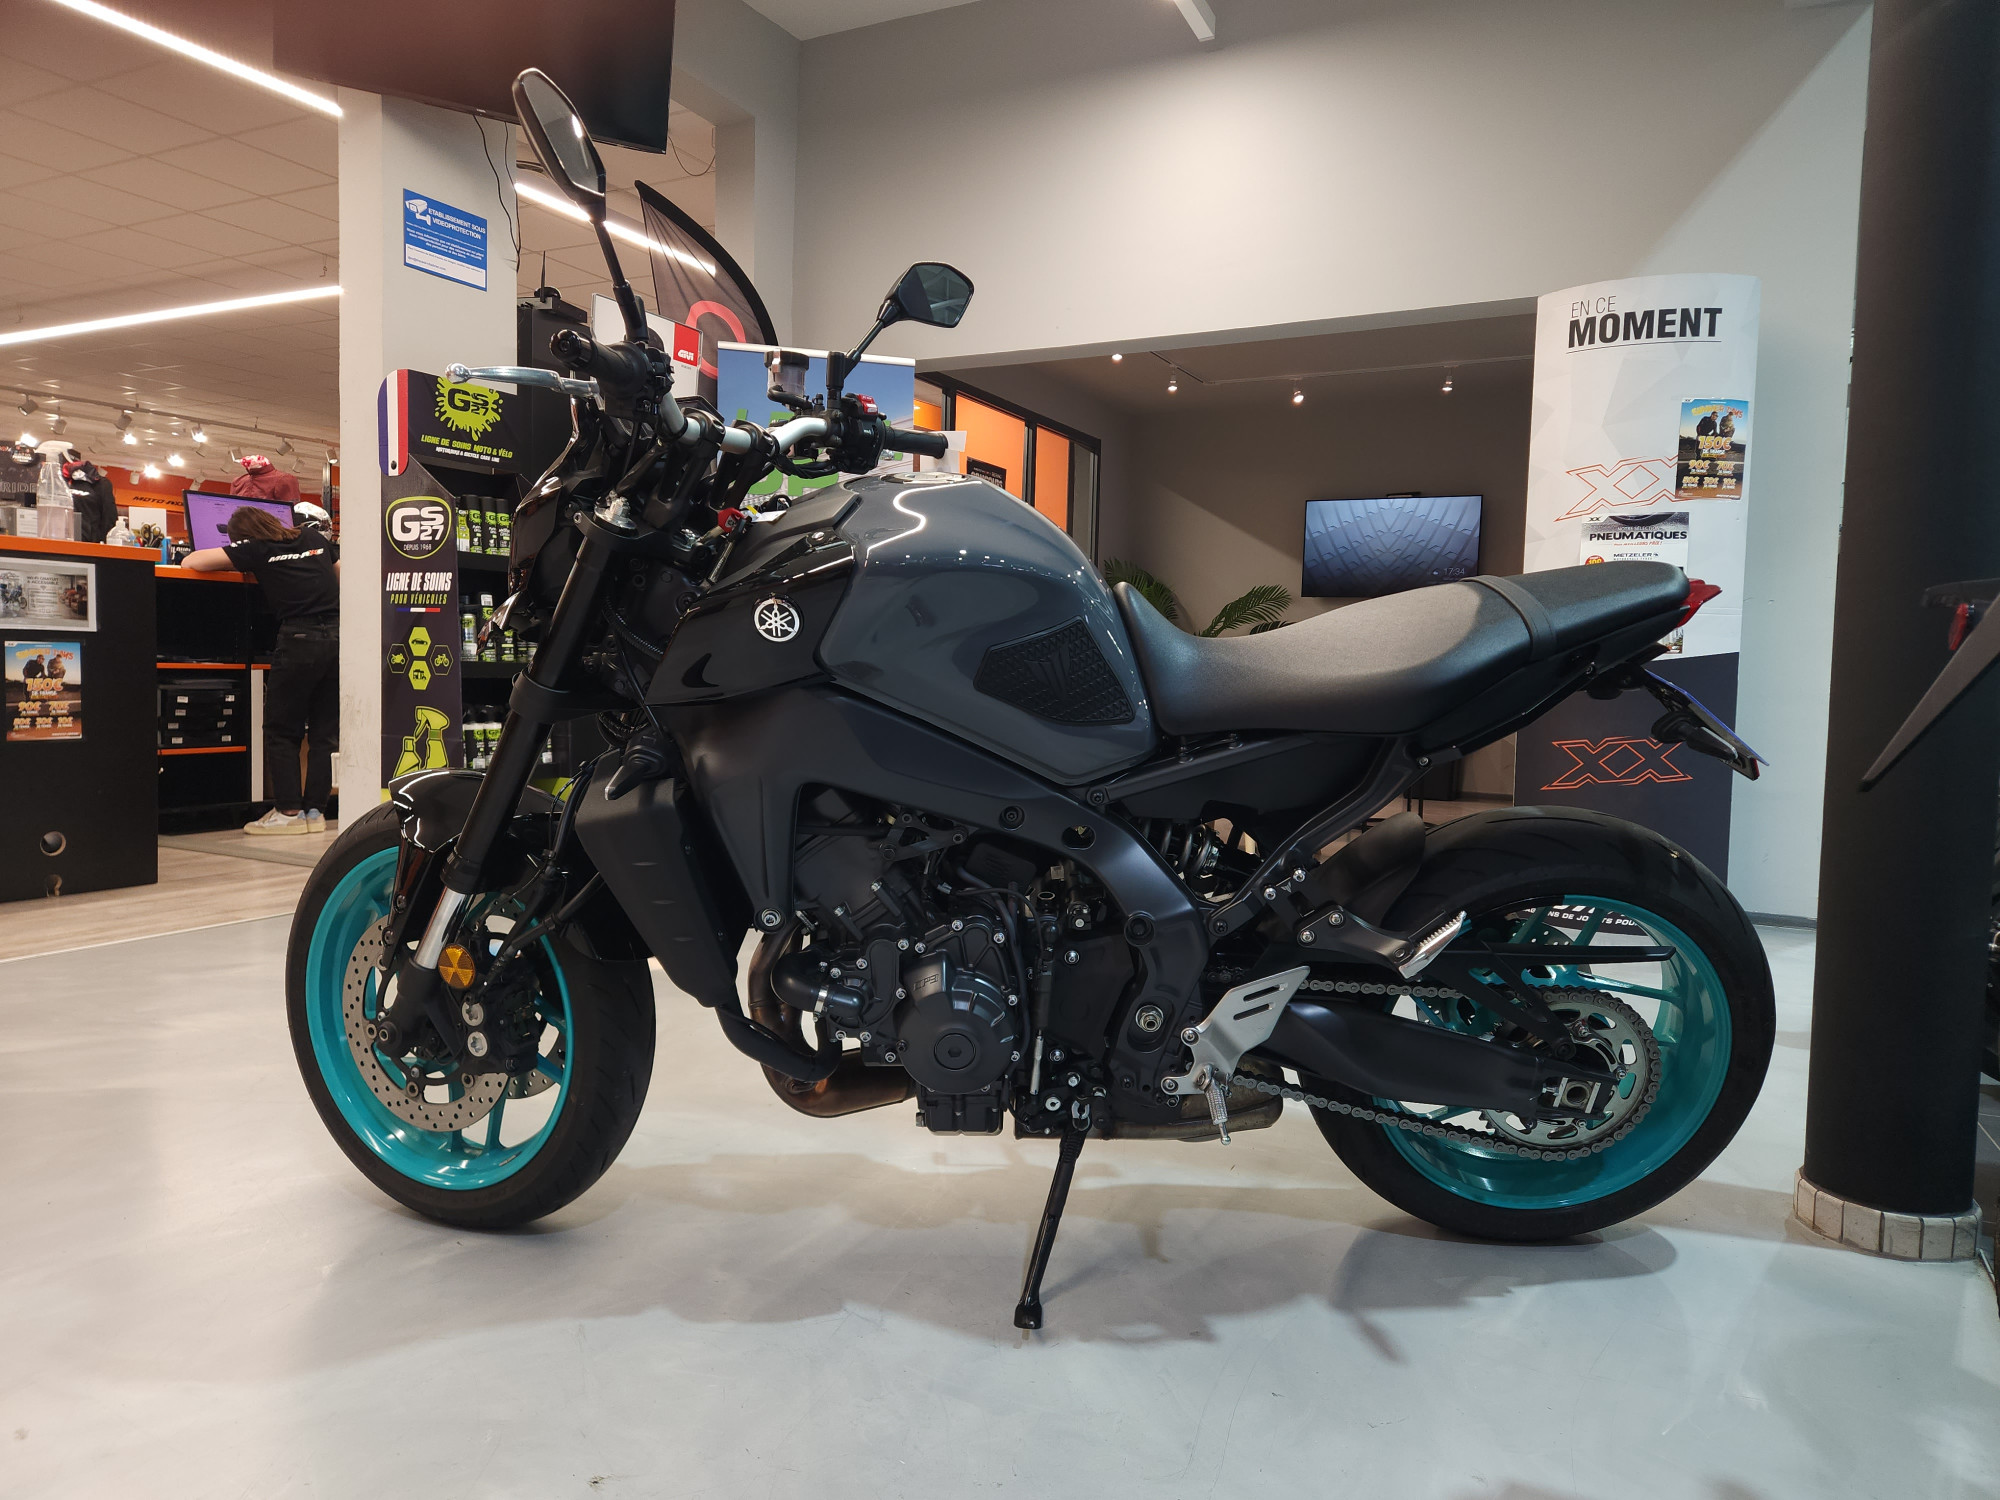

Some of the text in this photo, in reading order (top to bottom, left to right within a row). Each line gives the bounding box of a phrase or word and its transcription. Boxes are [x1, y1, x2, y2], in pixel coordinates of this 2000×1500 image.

[428, 207, 486, 234] ETABLISSEMENT SOUS
[432, 216, 482, 239] VIDEOPROTECTION
[1571, 295, 1616, 318] EN CE
[1568, 307, 1723, 348] MOMENT
[421, 434, 513, 459] LIGNE DE SOINS MOTO & VÉLO
[1698, 435, 1732, 450] 150€
[1589, 530, 1688, 541] PNEUMATIQUES
[403, 543, 419, 551] DEPUIS
[1444, 568, 1465, 576] 17:34
[386, 572, 453, 591] LIGNE DE SOINS
[390, 592, 448, 605] POUR VÉHICULES
[1561, 912, 1575, 920] DE
